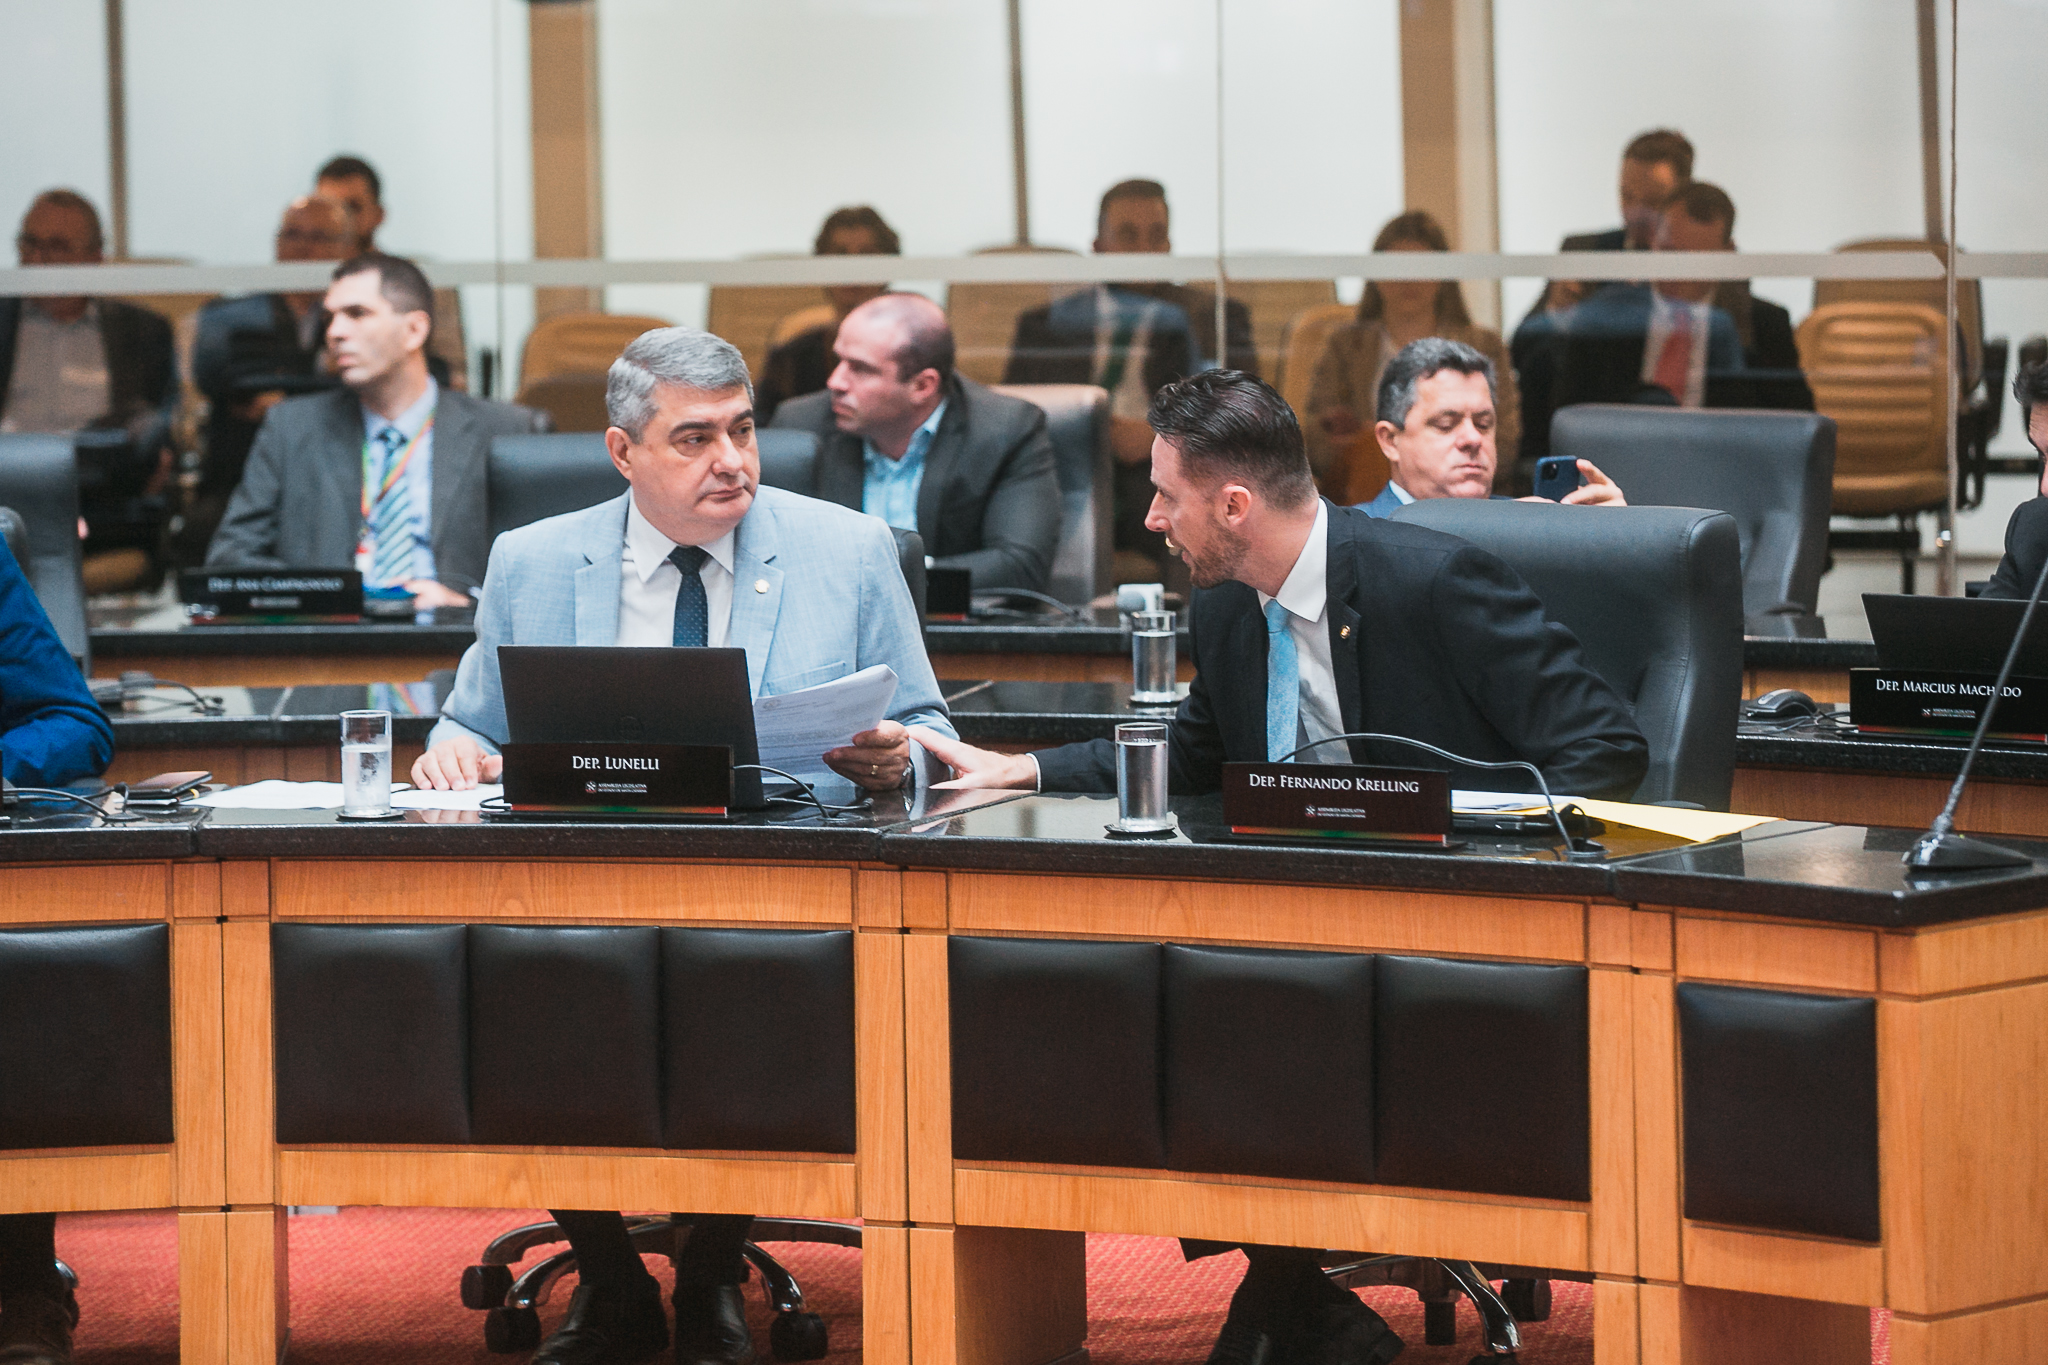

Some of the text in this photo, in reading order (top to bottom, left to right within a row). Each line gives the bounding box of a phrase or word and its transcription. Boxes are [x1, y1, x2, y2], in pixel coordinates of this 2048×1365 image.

[1875, 678, 2022, 698] DEP. MARCIUS MACHDO
[572, 755, 660, 770] DEP. LUNELLI
[1248, 773, 1420, 793] DEP. FERNANDO KRELLING
